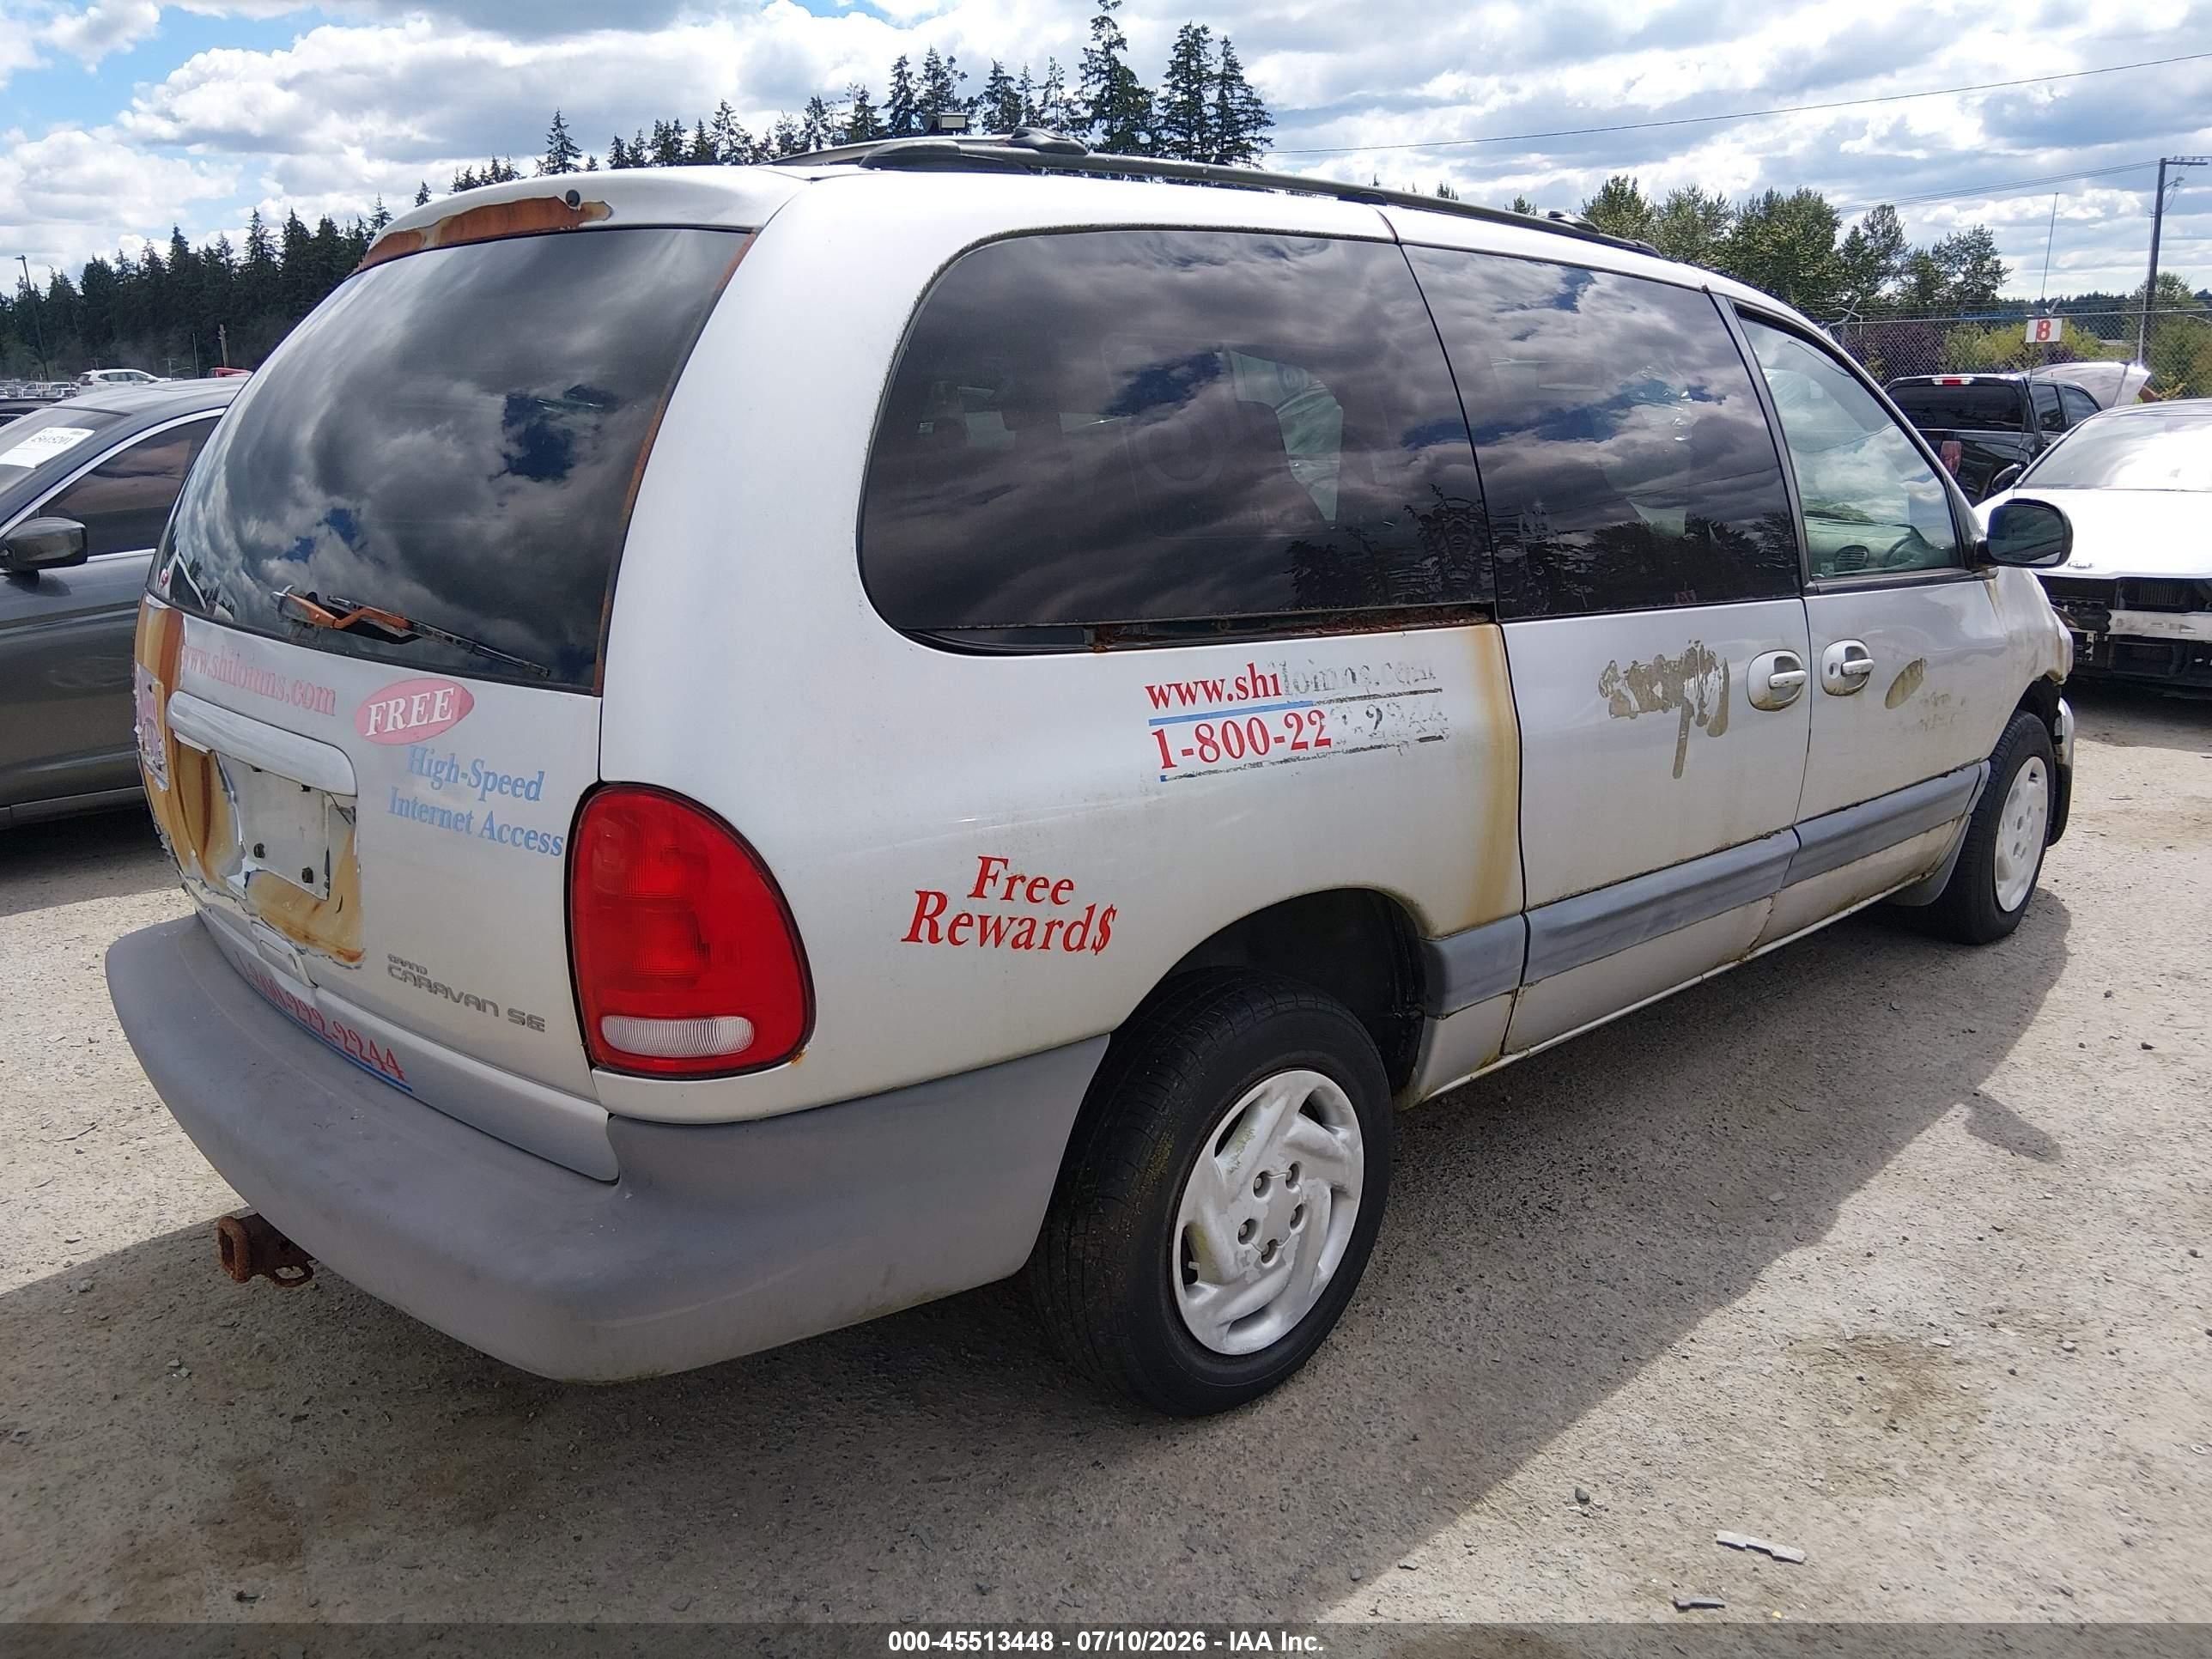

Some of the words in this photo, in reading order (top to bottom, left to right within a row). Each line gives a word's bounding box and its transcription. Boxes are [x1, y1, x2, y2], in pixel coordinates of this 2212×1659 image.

[2036, 319, 2051, 341] 8
[365, 687, 455, 737] FREE
[406, 744, 545, 802] High-Speed
[388, 786, 474, 835] Internet
[478, 810, 564, 857] Access
[966, 855, 1075, 906] Free
[900, 890, 1118, 957] Reward$
[387, 953, 428, 975] GRAND
[387, 963, 499, 1018] CARAVAN
[507, 1007, 545, 1032] SE
